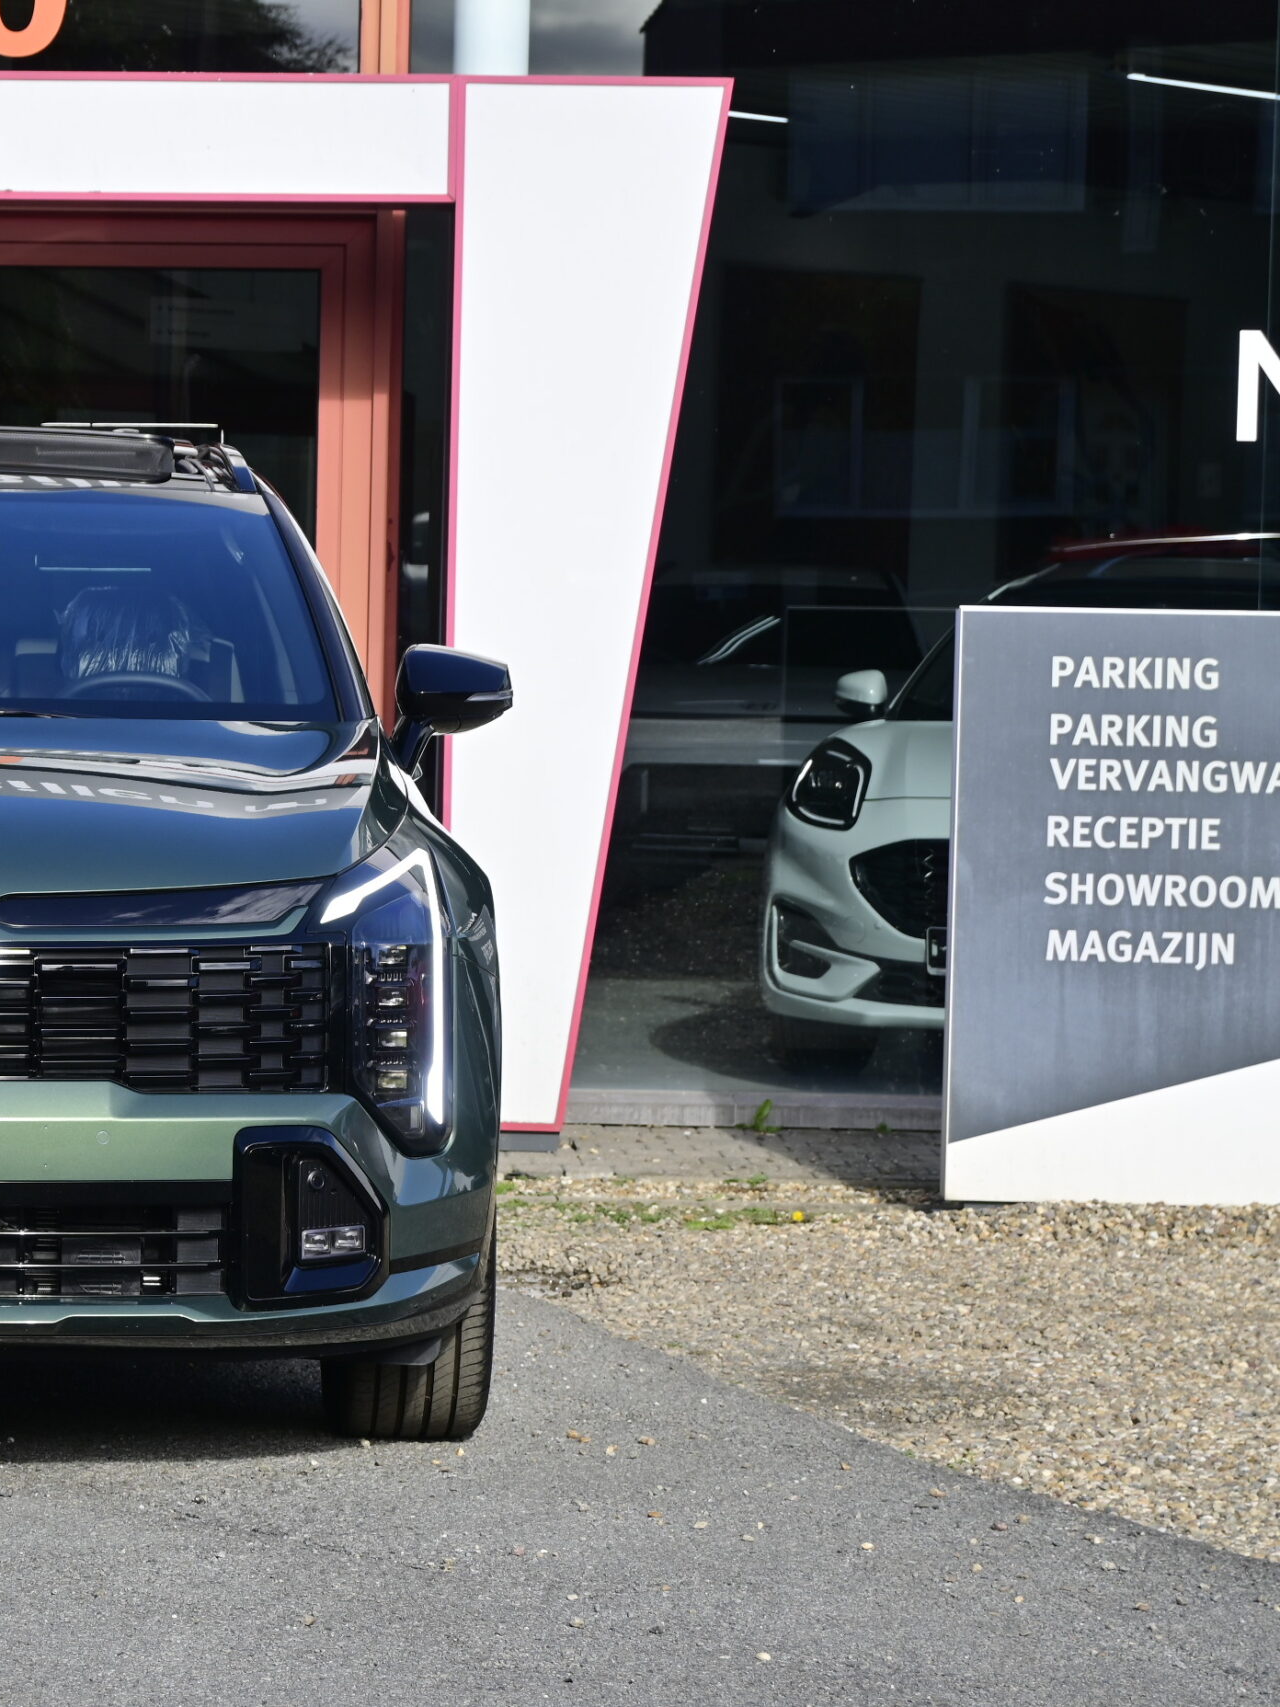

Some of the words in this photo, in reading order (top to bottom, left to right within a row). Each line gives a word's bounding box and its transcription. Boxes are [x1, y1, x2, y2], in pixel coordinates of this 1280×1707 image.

[1050, 655, 1220, 691] PARKING
[1048, 713, 1218, 748] PARKING
[1045, 815, 1222, 850] RECEPTIE
[1042, 871, 1280, 909] SHOWROOM
[1044, 929, 1236, 971] MAGAZIJN
